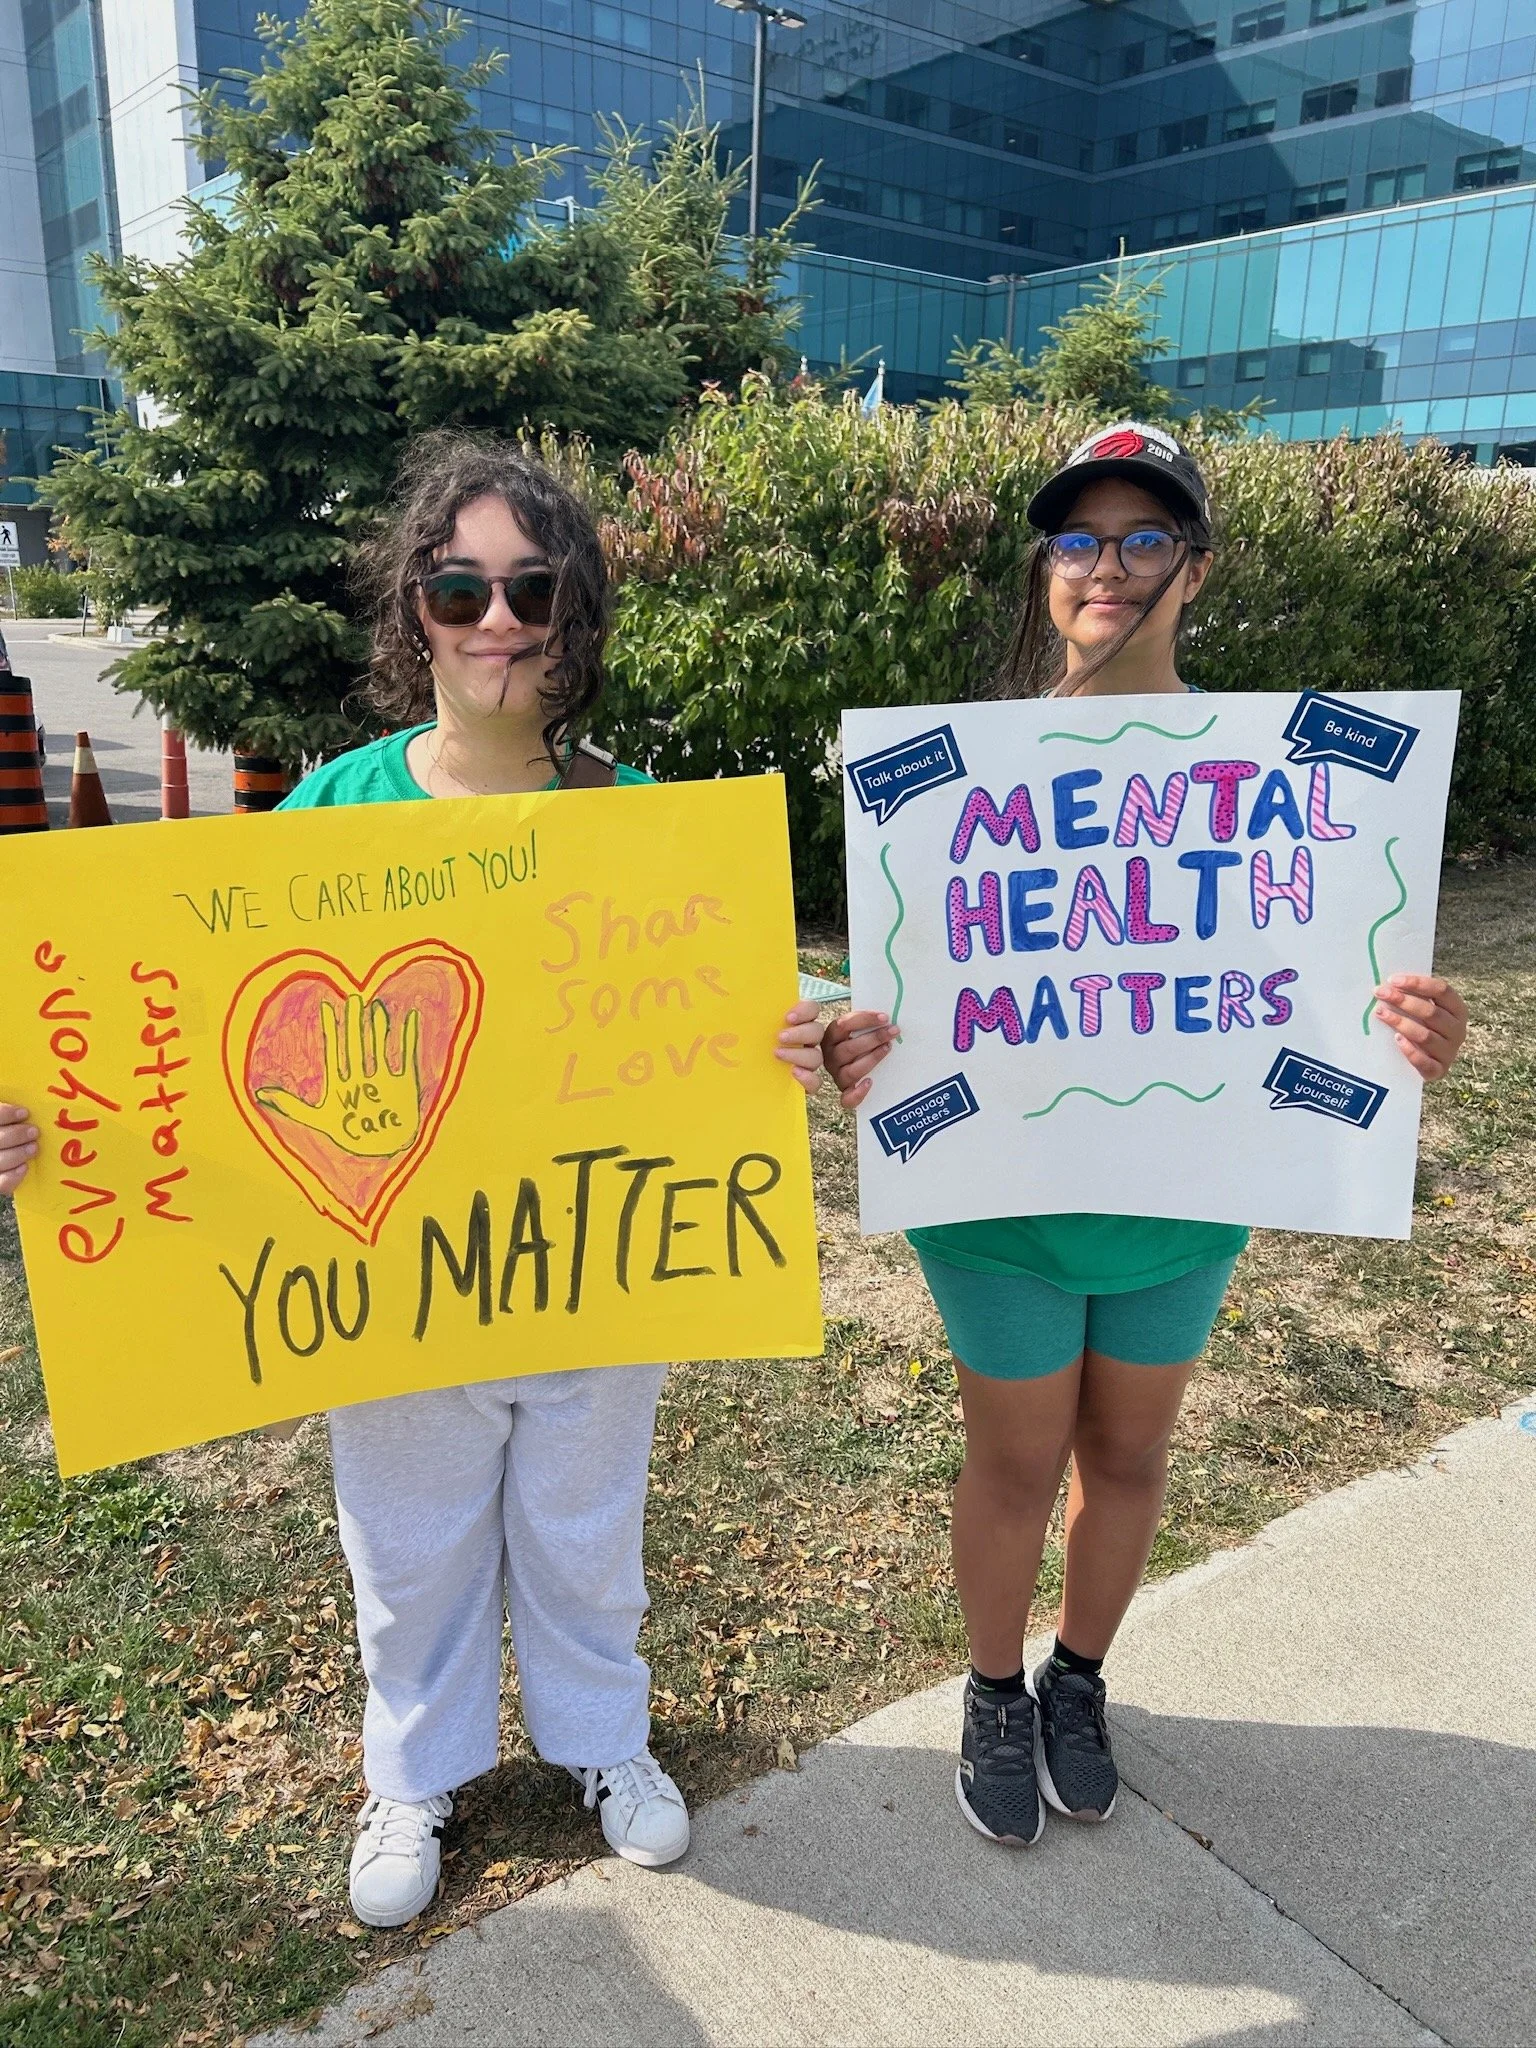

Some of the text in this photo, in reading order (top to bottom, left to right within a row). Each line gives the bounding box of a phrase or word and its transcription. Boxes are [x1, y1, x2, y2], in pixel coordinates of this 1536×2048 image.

[864, 750, 946, 789] Talk about it
[1324, 720, 1378, 748] Be kind
[949, 760, 1357, 864] MENTAL
[173, 829, 537, 934] WE CARE ABOUT YOU!
[946, 845, 1314, 962] HEALTH
[541, 891, 733, 973] Share
[953, 967, 1299, 1053] MATTERS
[34, 940, 125, 1264] everyone
[555, 1032, 742, 1105] Love
[1293, 1083, 1351, 1109] yourself
[1301, 1067, 1354, 1096] Educate
[893, 1091, 951, 1126] Language
[905, 1107, 950, 1136] matters
[218, 1145, 788, 1386] YOU MATTER
